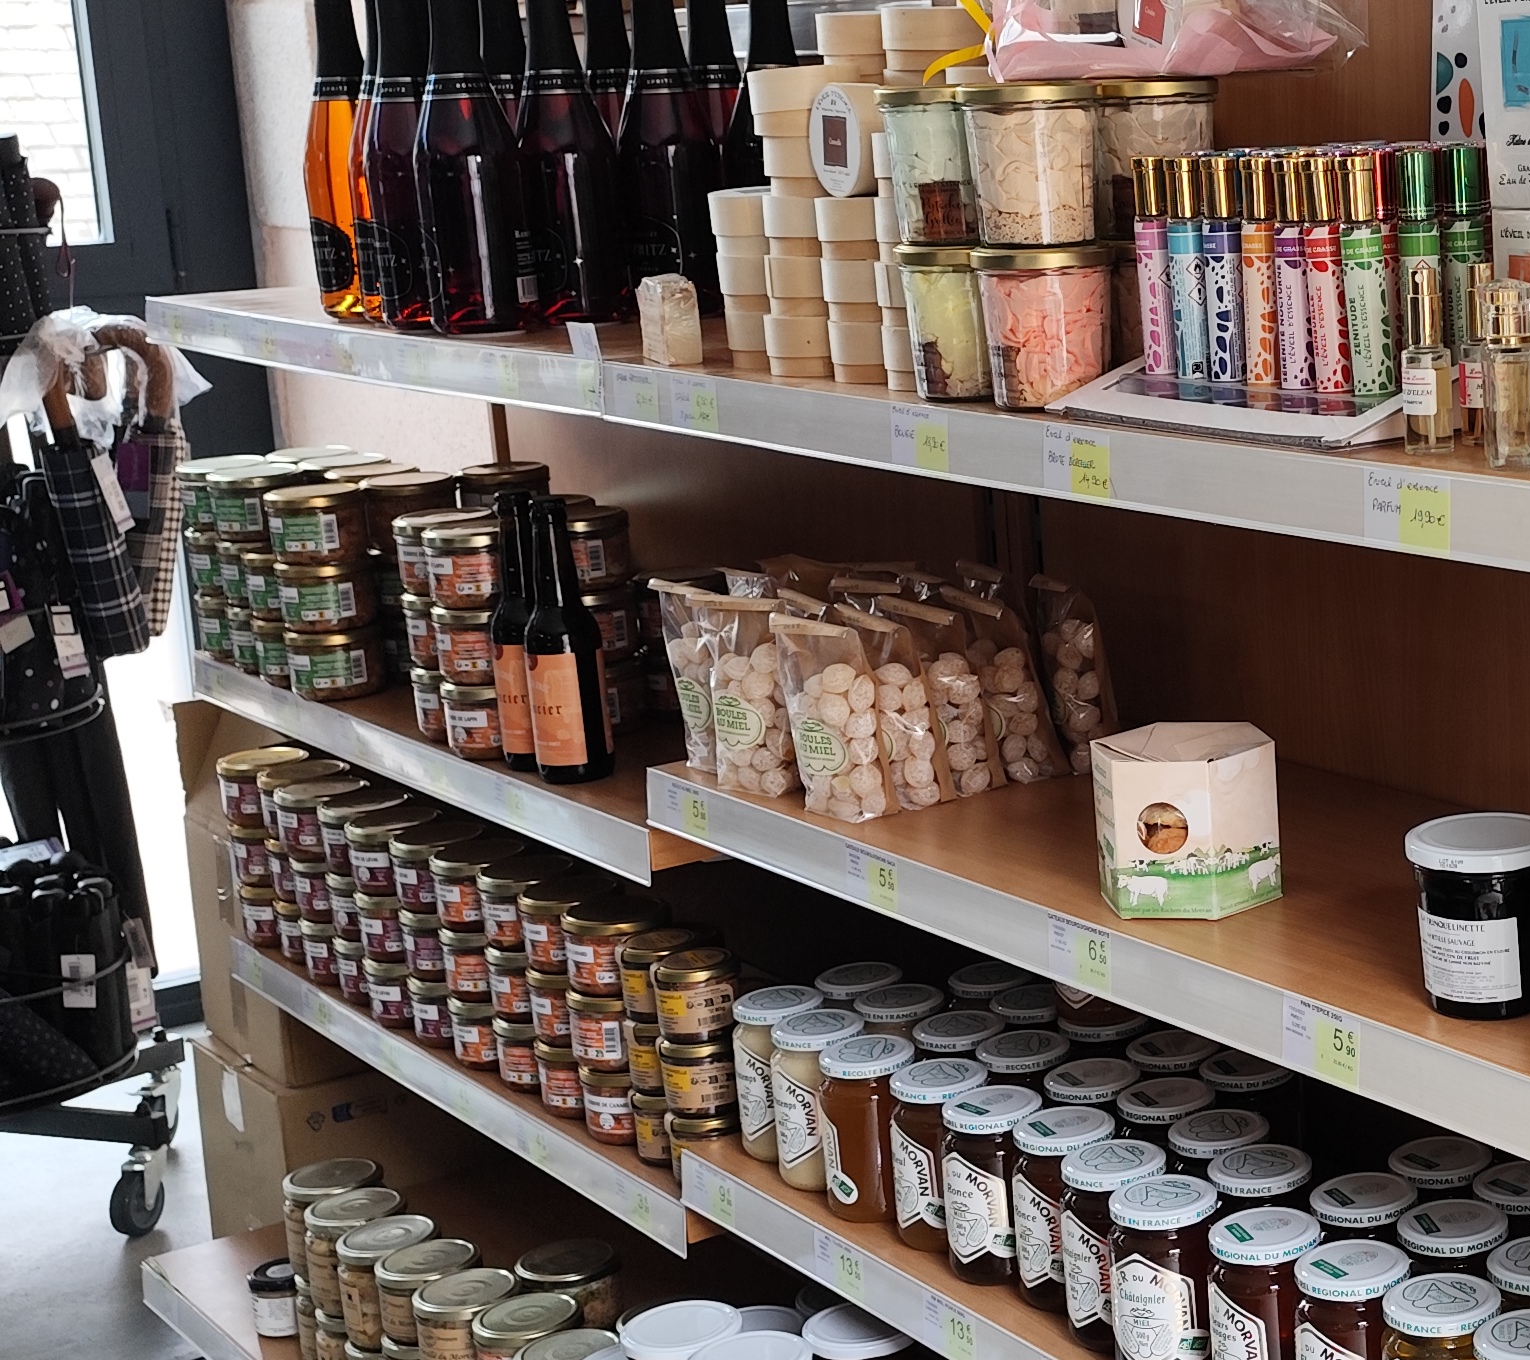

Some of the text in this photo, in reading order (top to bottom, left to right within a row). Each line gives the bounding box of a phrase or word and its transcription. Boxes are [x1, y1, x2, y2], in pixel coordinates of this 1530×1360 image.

[1348, 296, 1362, 356] ZENITUDE
[715, 707, 748, 721] BOULES
[726, 720, 751, 731] MIEL
[808, 745, 837, 756] MIEL
[1332, 1027, 1344, 1052] 5
[1345, 1045, 1356, 1058] 90
[785, 1084, 818, 1137] MORVAN
[898, 1140, 930, 1197] MORVAN
[947, 1183, 975, 1200] Ronce
[964, 1172, 1000, 1228] MORVAN
[1029, 1196, 1061, 1255] MORVAN
[1142, 1216, 1182, 1227] FRANCE
[1077, 1231, 1112, 1294] MORVAN
[1119, 1290, 1167, 1306] Châtaignier
[1311, 1286, 1363, 1298] REGIONAL
[1132, 1317, 1152, 1328] MIEL
[1402, 1322, 1443, 1335] FRANCE
